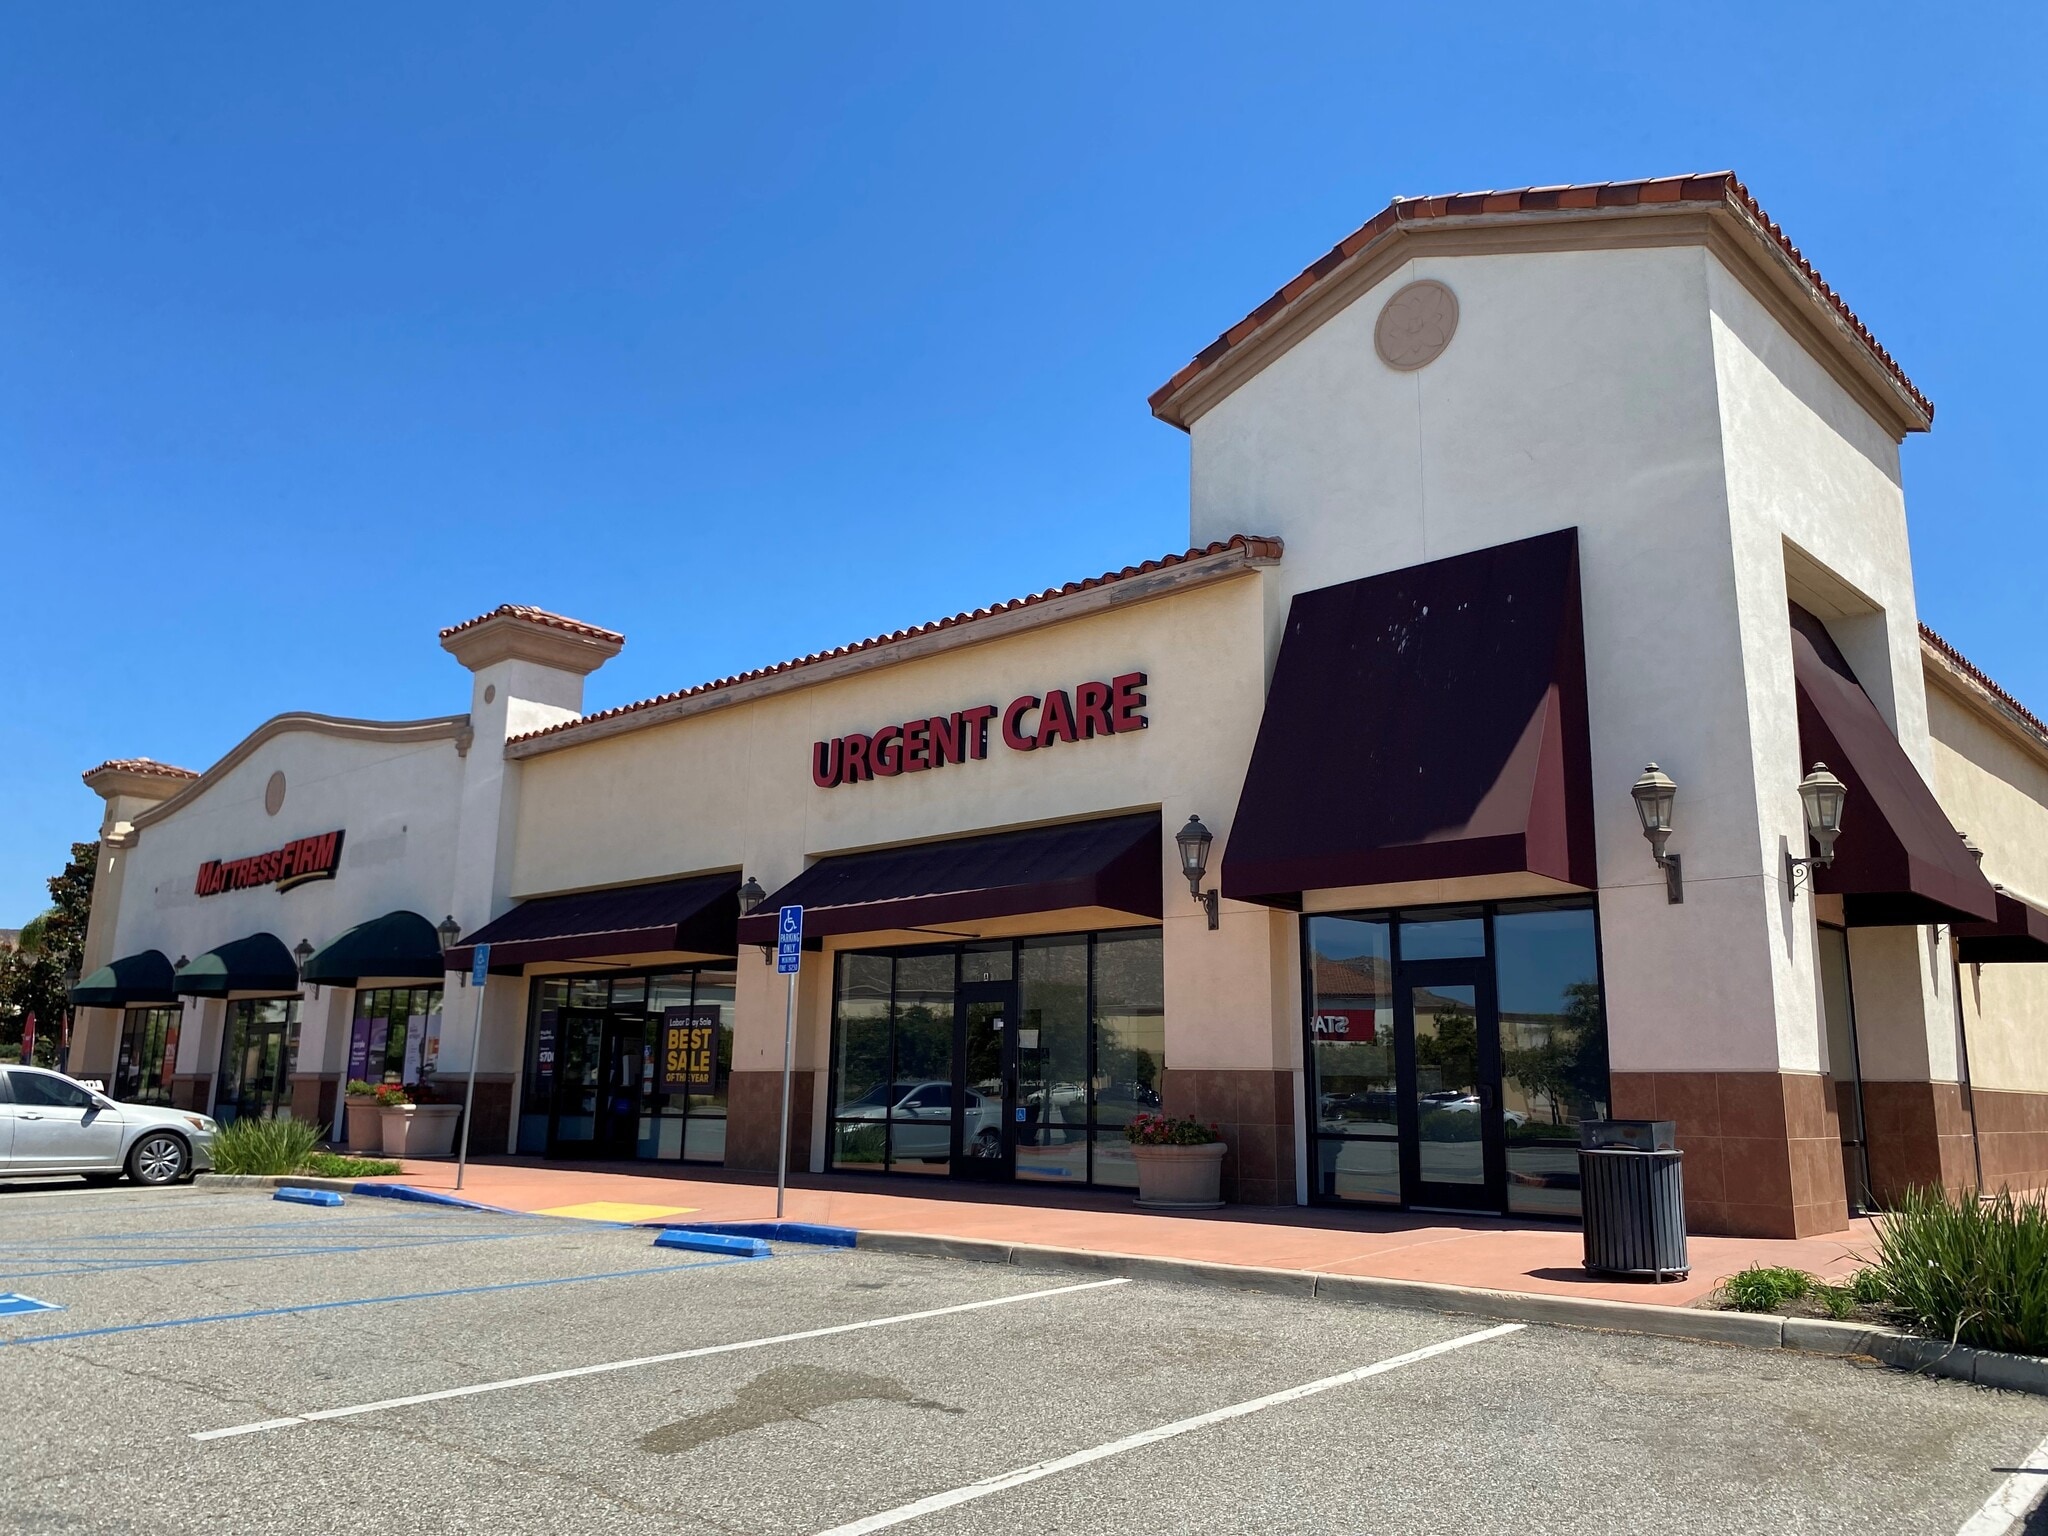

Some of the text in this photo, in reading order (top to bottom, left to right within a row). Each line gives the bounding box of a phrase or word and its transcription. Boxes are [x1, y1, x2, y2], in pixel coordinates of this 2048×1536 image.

[813, 671, 1148, 788] URGENT CARE
[780, 933, 800, 942] PARKING
[783, 944, 796, 953] ONLY
[669, 1016, 712, 1028] Labor Day Sale
[667, 1028, 712, 1050] BEST
[666, 1050, 711, 1072] SALE
[665, 1072, 676, 1082] OF
[691, 1073, 709, 1083] YEAR
